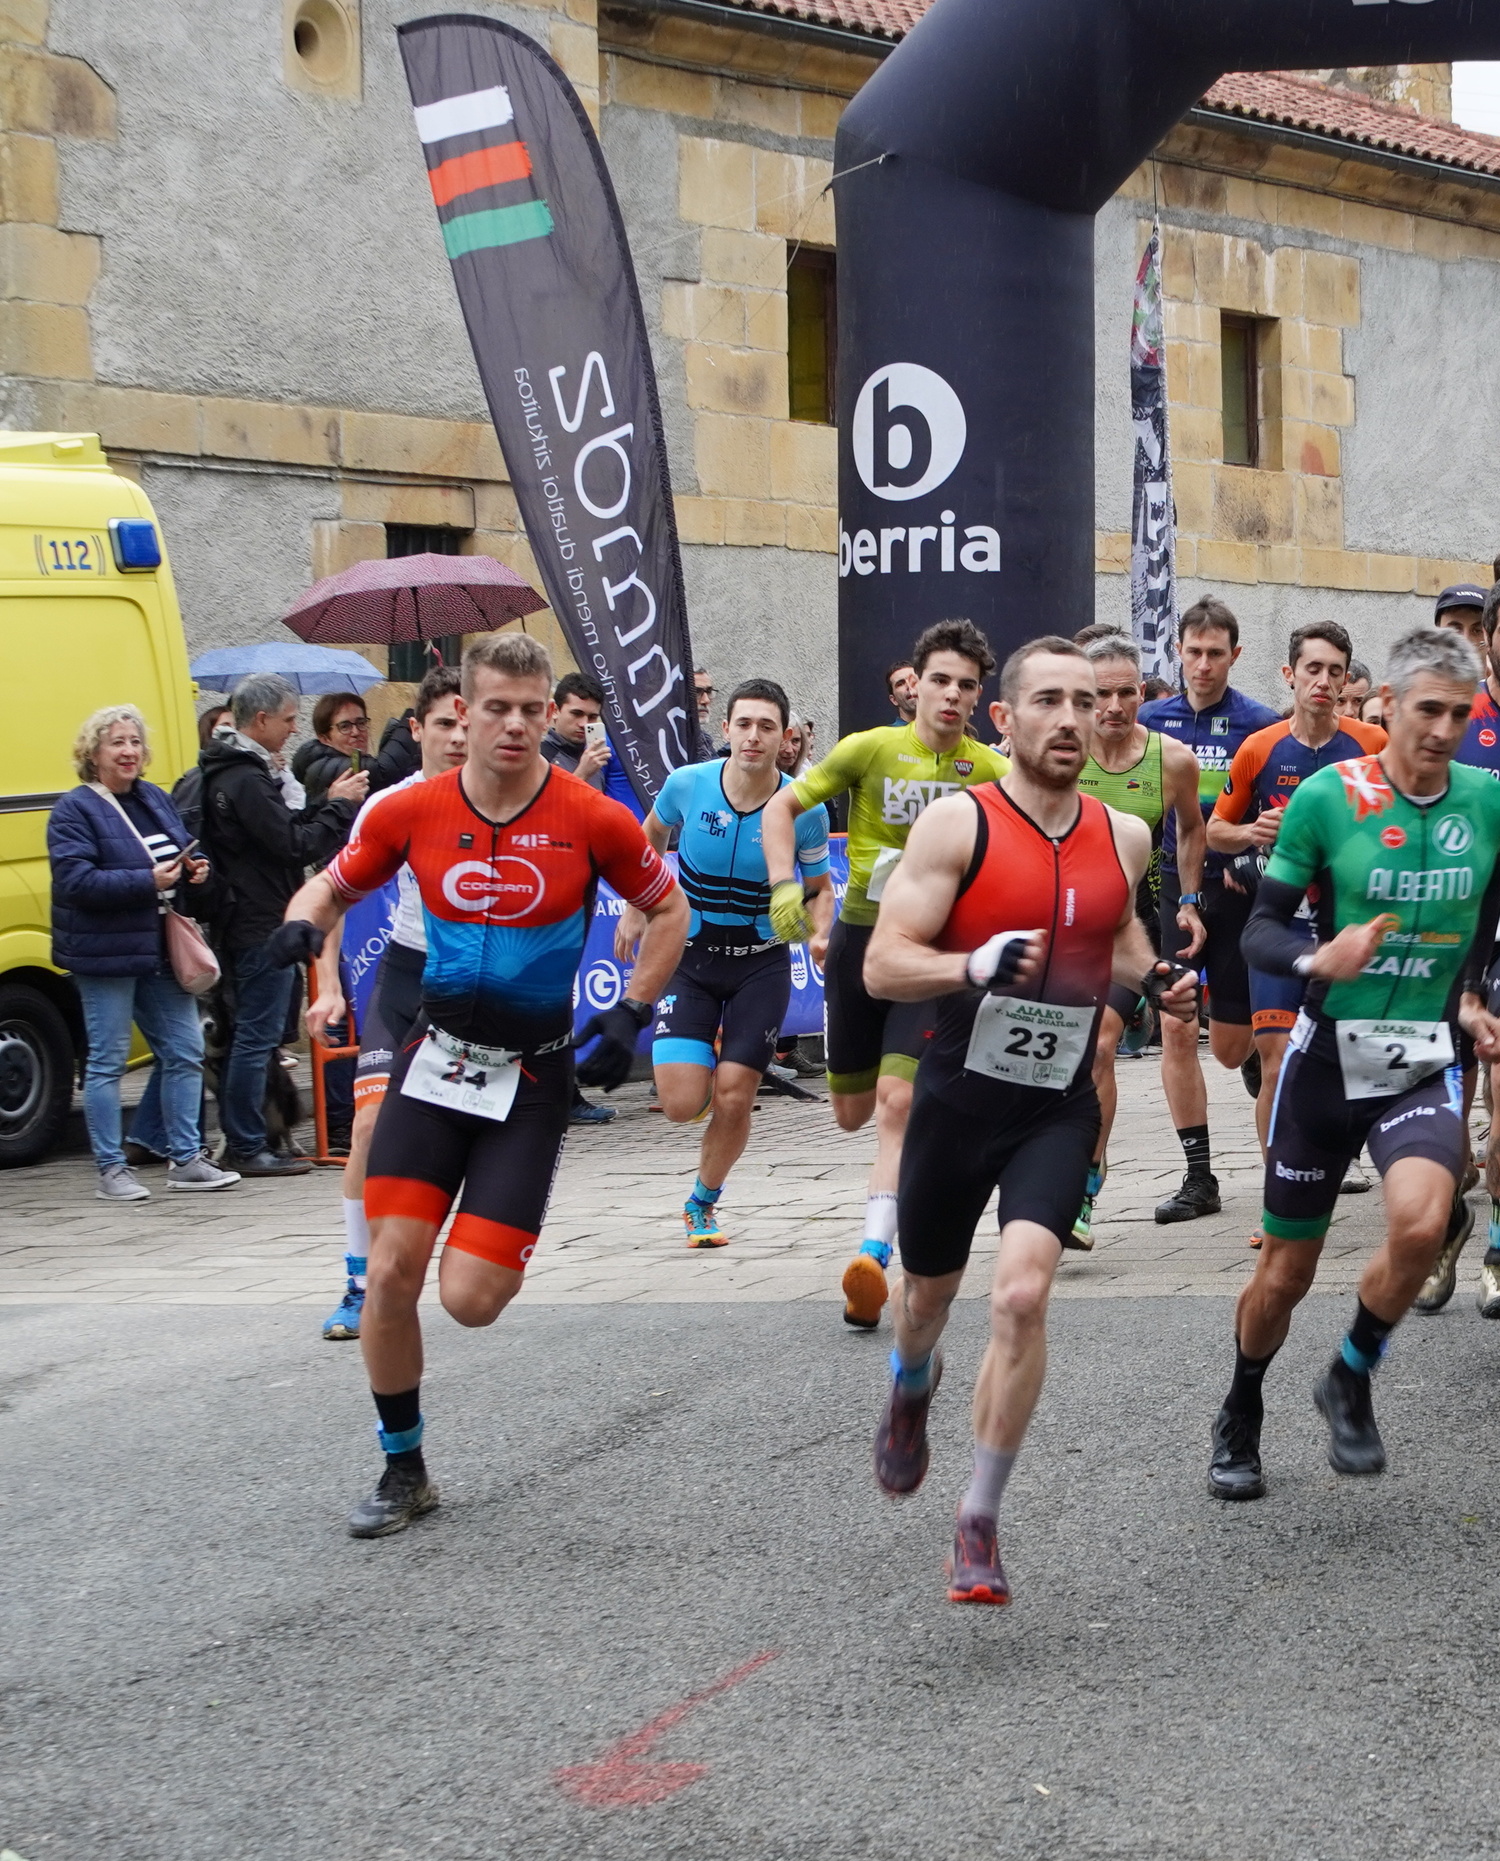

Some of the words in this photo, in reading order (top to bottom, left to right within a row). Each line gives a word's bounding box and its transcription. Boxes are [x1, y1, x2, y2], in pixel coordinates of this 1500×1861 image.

[48, 540, 92, 570] 112
[839, 510, 1000, 578] berria
[1366, 867, 1473, 901] ALBERTO
[1016, 1005, 1064, 1019] AIAKO
[1004, 1027, 1058, 1060] 23
[1386, 1043, 1410, 1070] 2
[441, 1061, 487, 1091] 24
[1381, 1106, 1436, 1132] berria
[1276, 1161, 1325, 1182] berria
